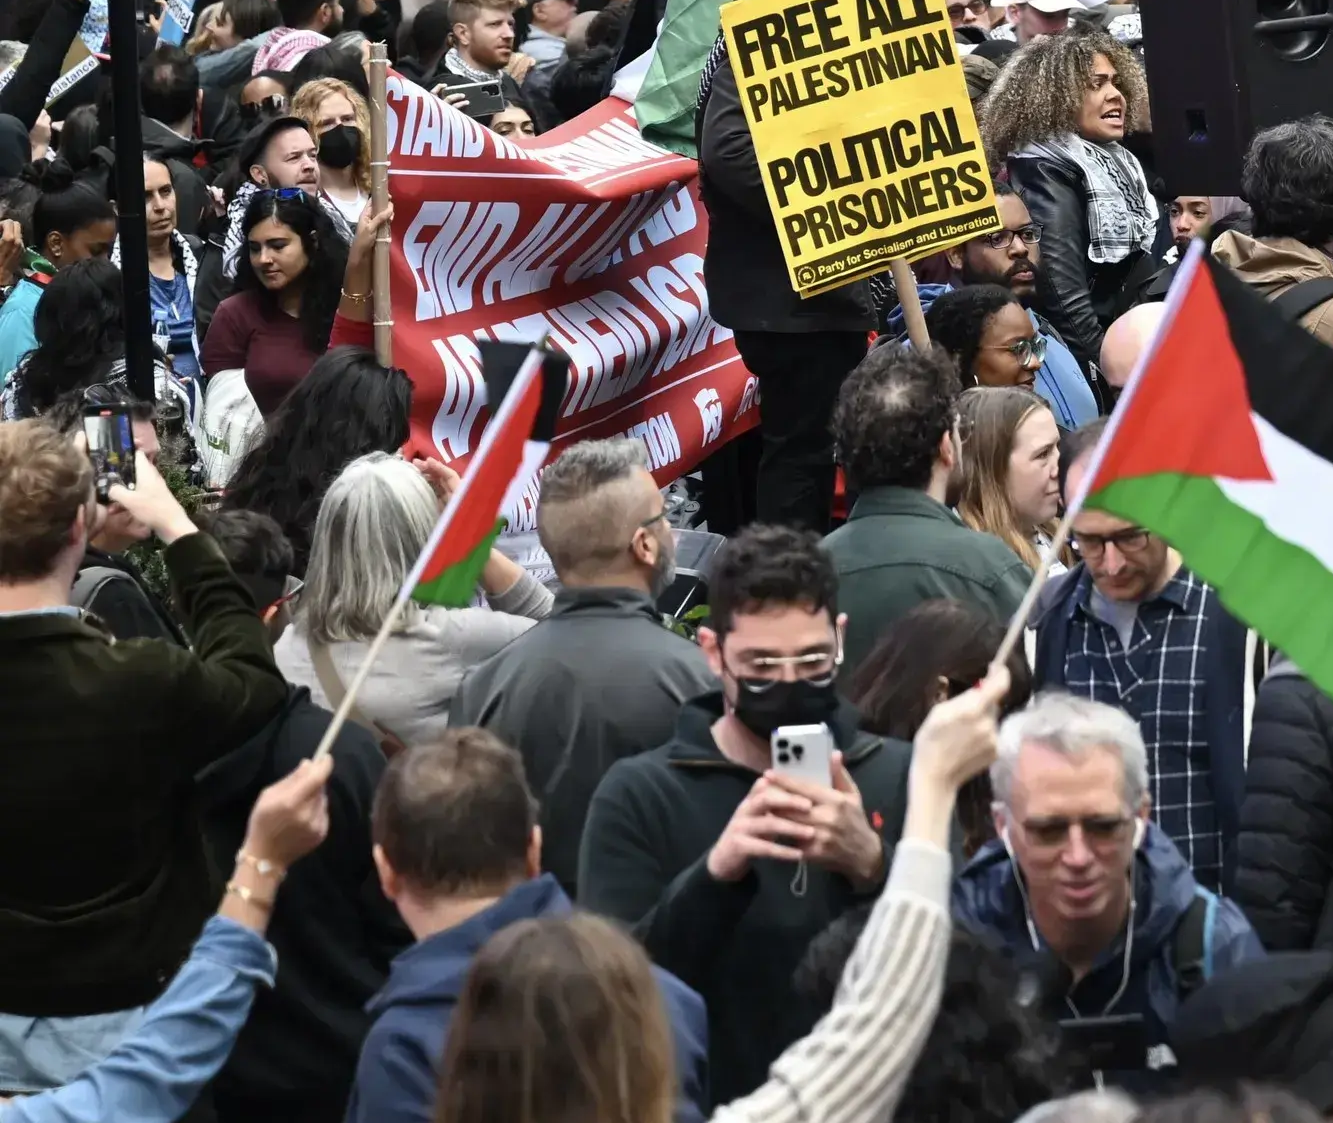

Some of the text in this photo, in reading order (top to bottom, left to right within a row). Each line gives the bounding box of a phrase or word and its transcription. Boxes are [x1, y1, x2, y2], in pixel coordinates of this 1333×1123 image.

[48, 60, 97, 100] esistance
[386, 75, 485, 158] STAND
[746, 29, 956, 123] PALESTINIAN
[767, 107, 976, 209] POLITICAL
[782, 161, 988, 258] PRISONERS
[817, 213, 997, 277] Party for Socialism and Liberation
[403, 201, 520, 322] END
[482, 200, 612, 306] ALL
